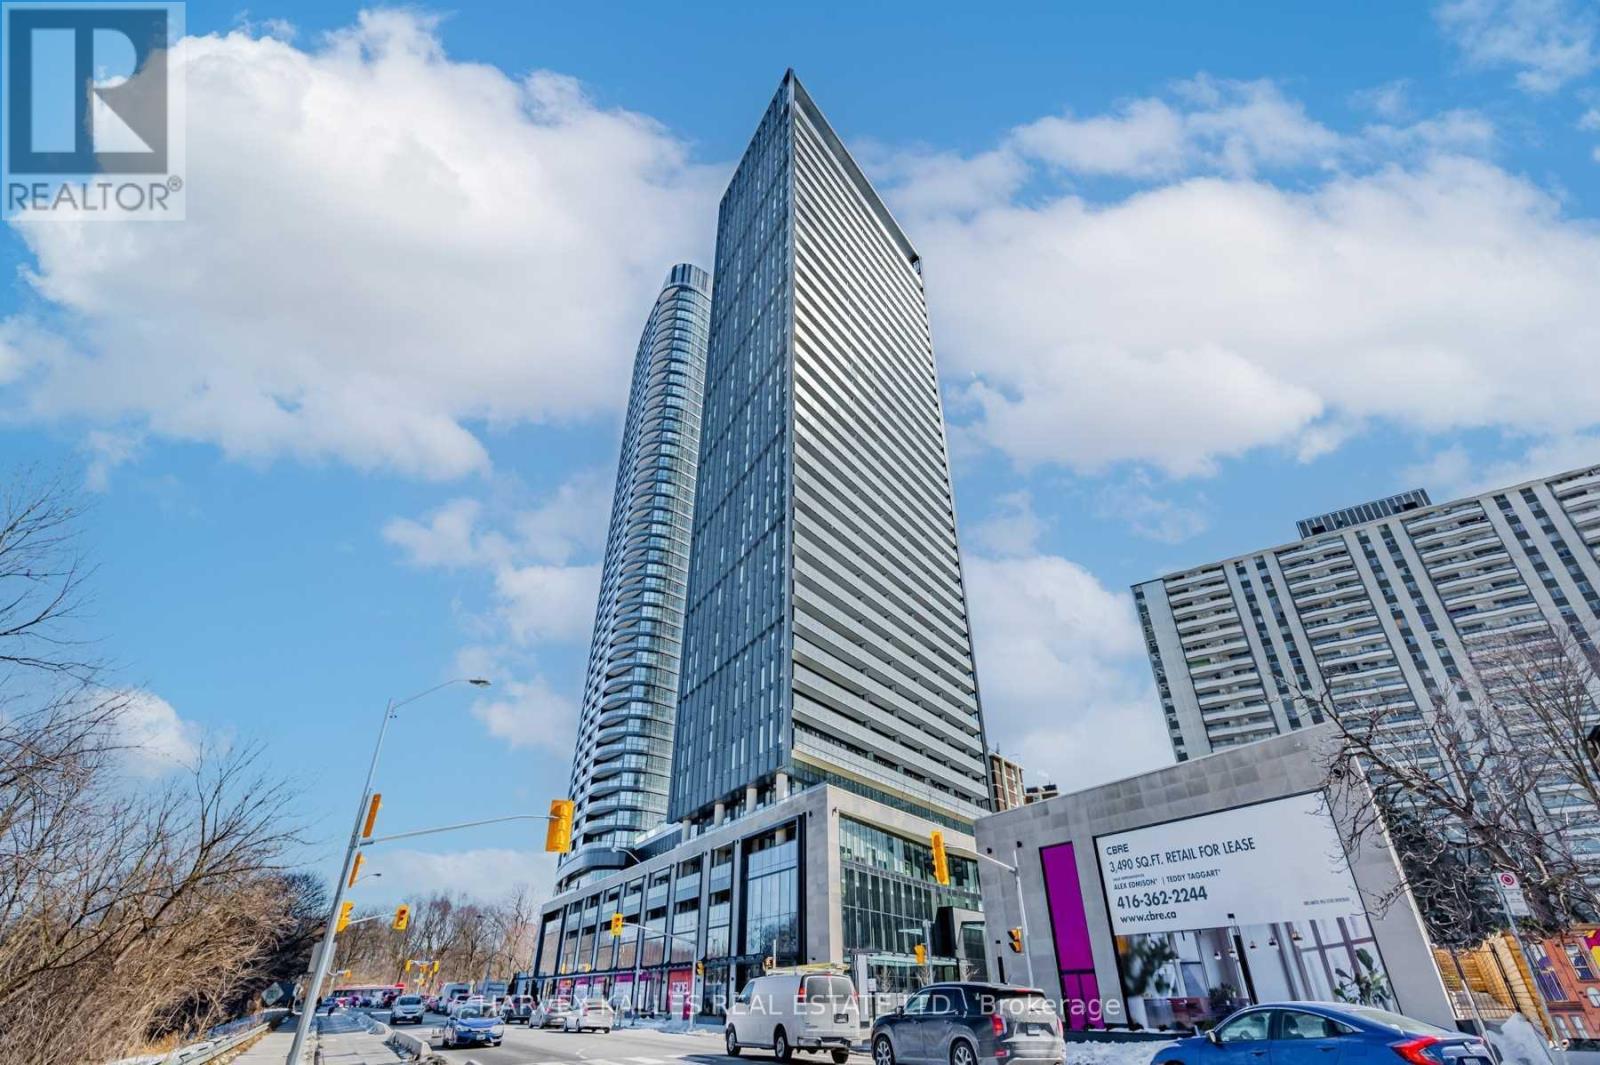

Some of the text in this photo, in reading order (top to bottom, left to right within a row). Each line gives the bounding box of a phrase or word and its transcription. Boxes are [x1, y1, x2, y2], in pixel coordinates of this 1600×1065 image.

[1106, 843, 1130, 856] CBRE
[1109, 837, 1256, 873] 3,490 SQ.FT. RETAIL FOR LEASE
[1117, 885, 1208, 909] 416-362-2244
[1119, 911, 1177, 924] www.cbre.ca
